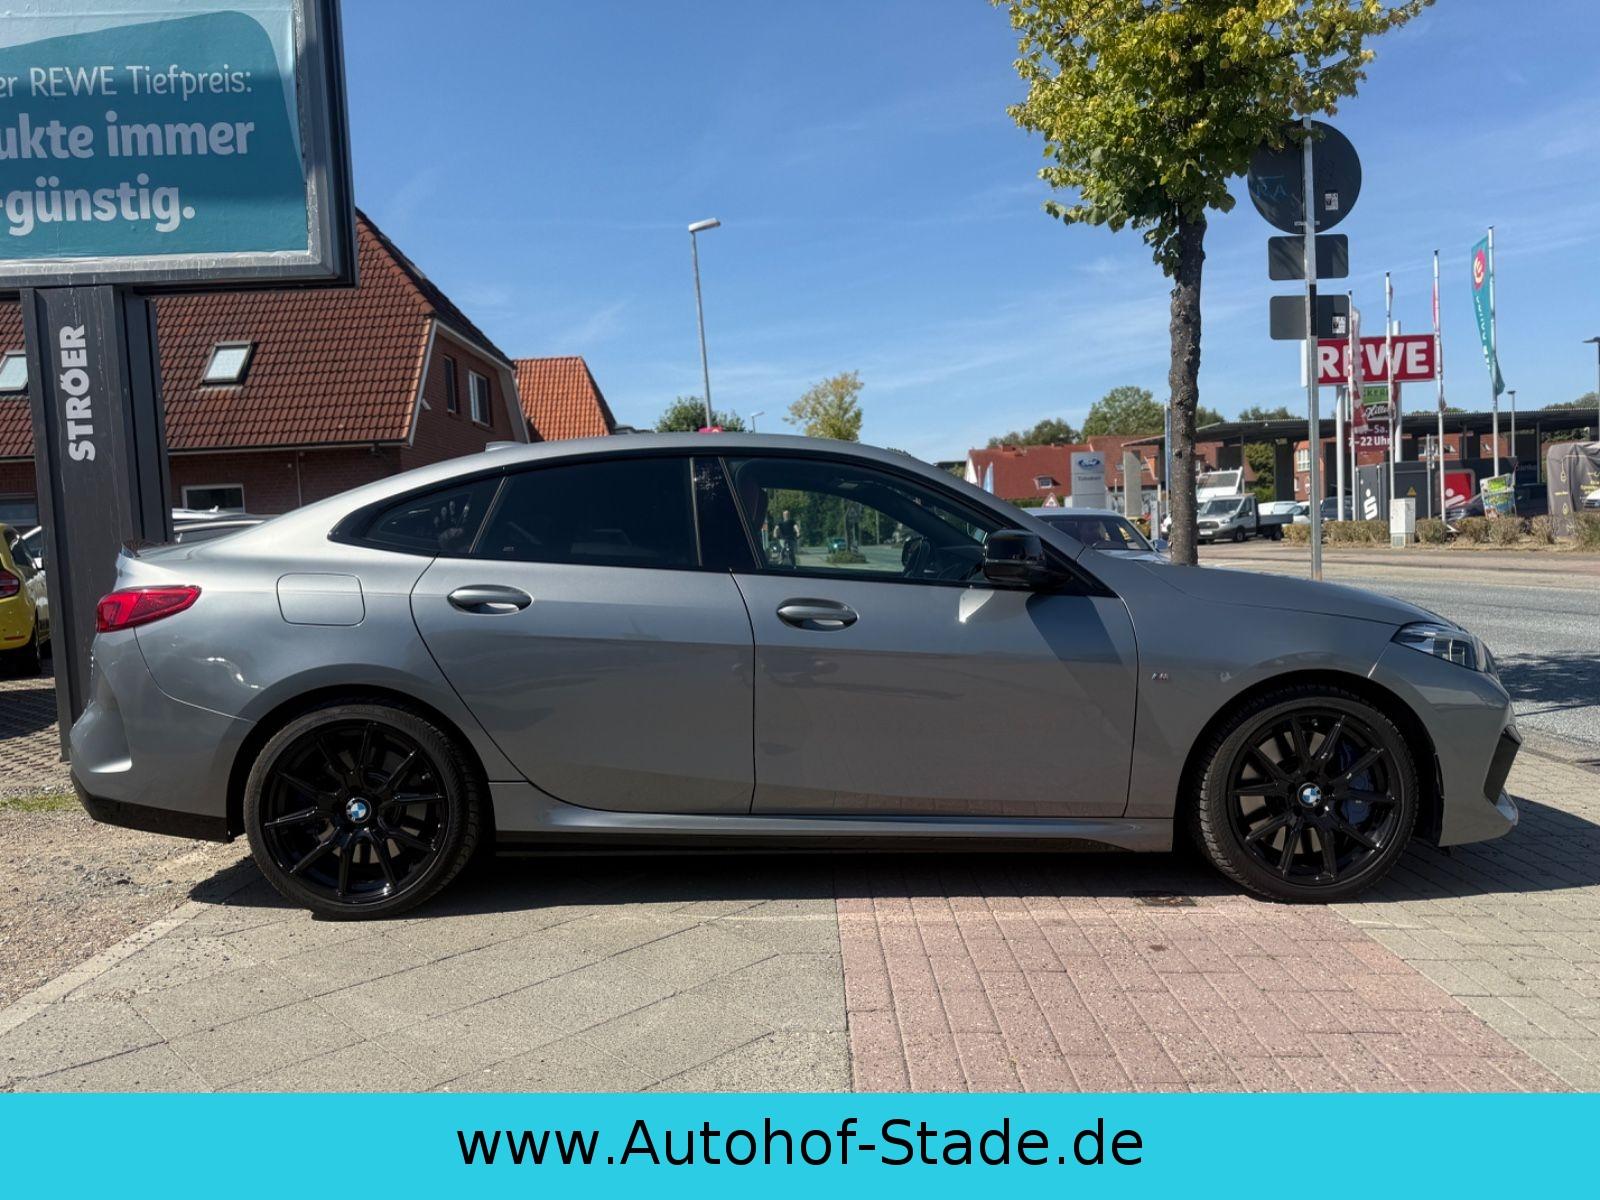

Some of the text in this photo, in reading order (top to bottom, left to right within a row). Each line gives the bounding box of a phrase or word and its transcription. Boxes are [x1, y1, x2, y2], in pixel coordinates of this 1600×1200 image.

[30, 66, 118, 97] REWE
[126, 64, 252, 101] Tiefpreis:
[105, 110, 254, 157] immer
[59, 324, 96, 462] STRÖER
